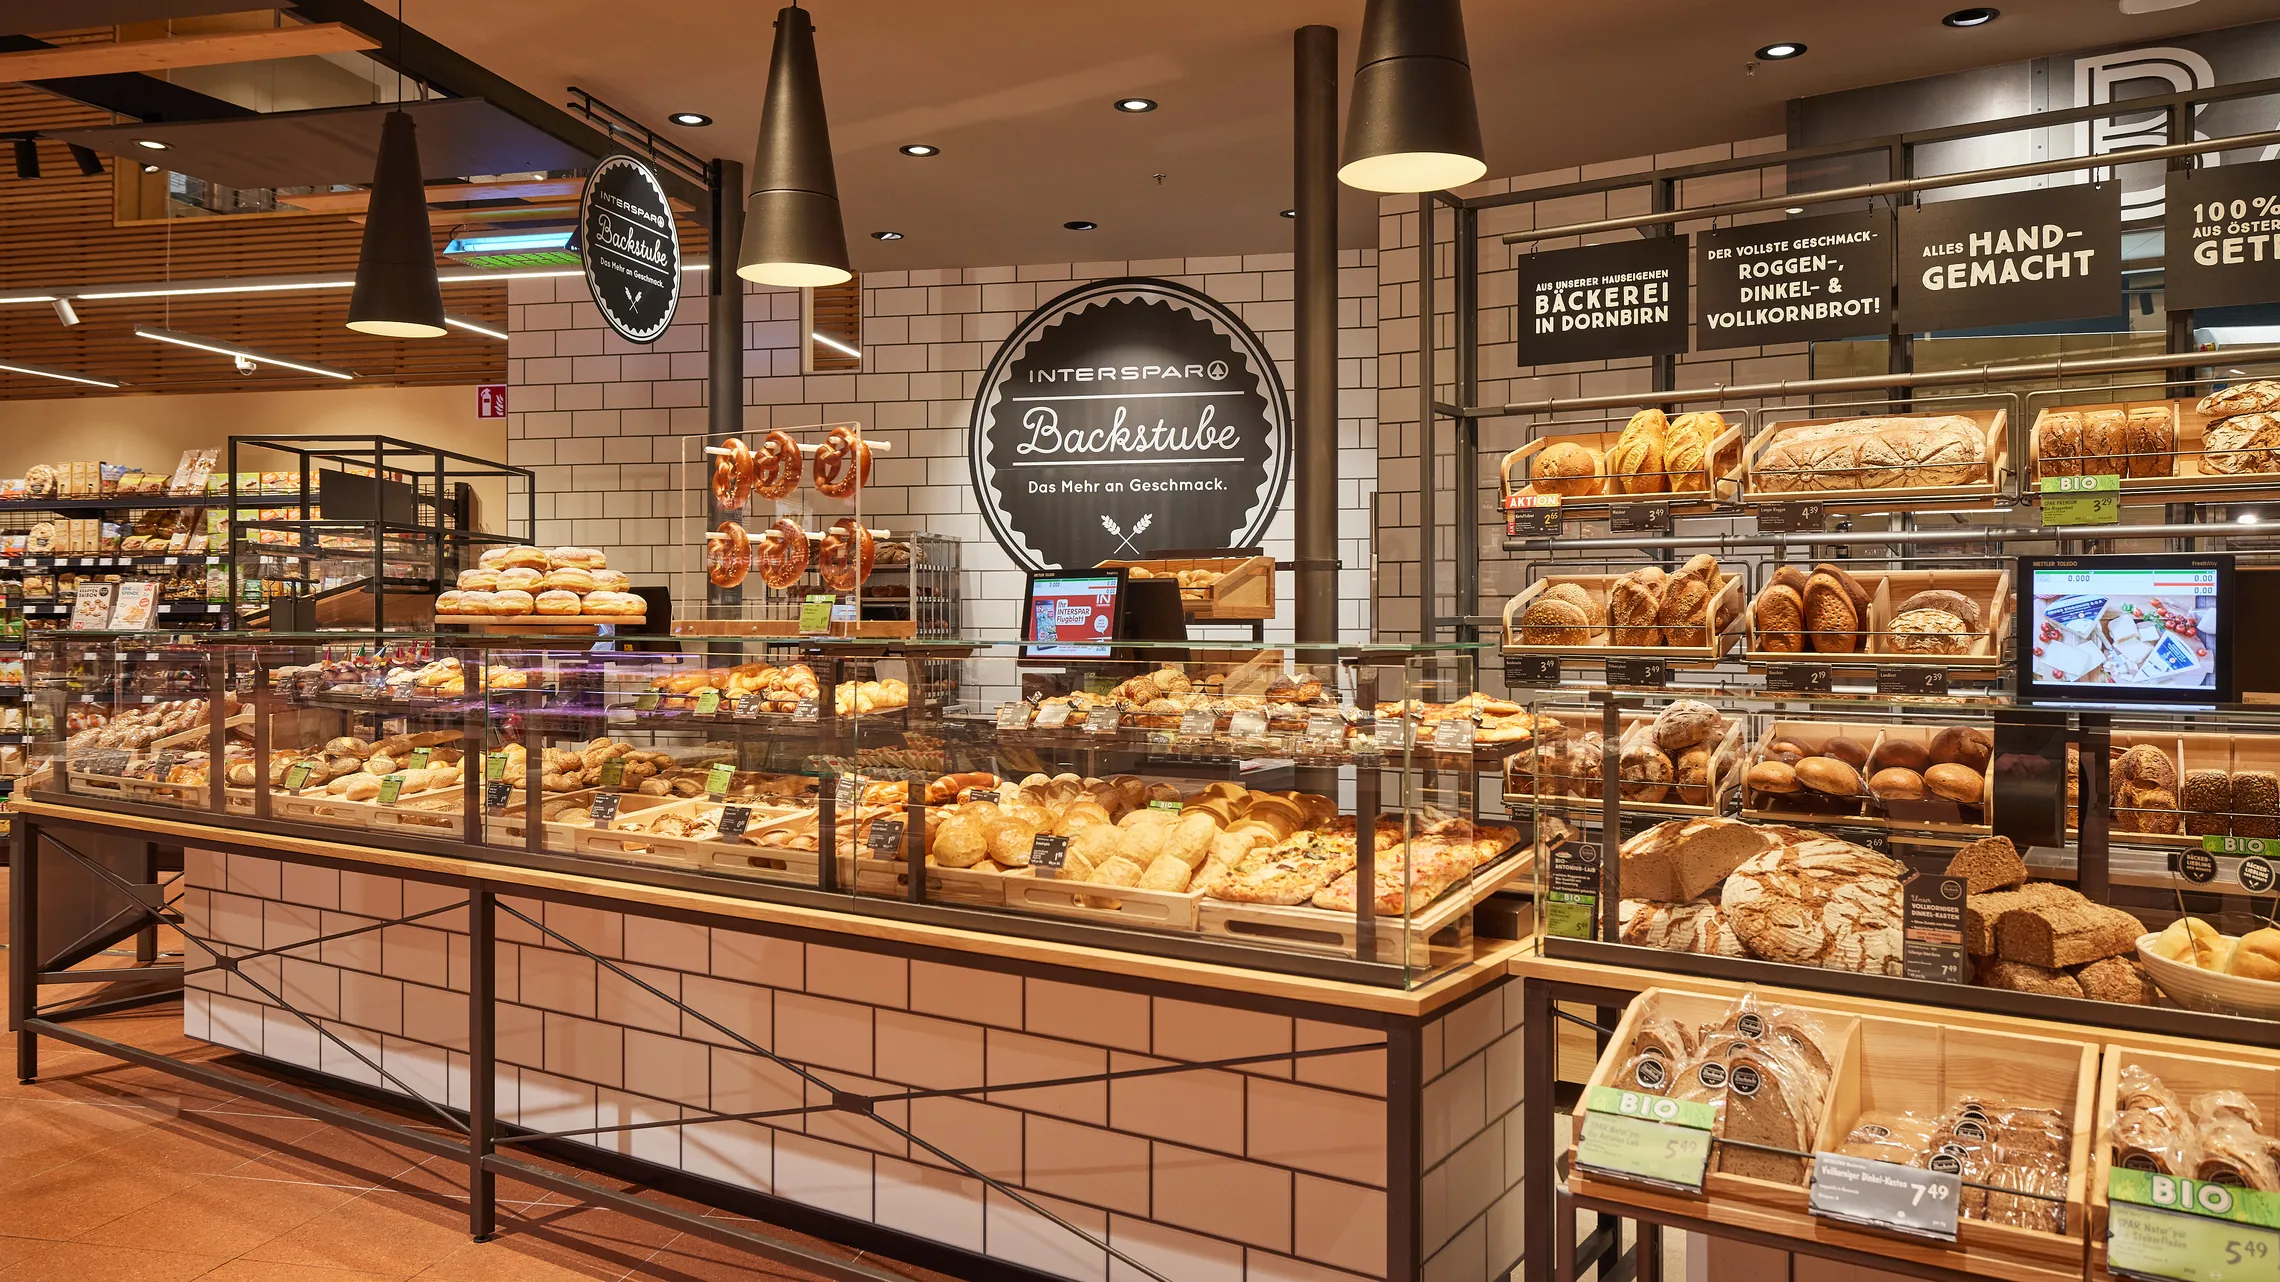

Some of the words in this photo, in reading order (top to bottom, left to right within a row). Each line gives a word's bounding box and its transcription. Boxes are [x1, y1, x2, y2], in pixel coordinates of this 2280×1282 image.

[600, 190, 658, 225] INTERSPAR
[596, 213, 668, 267] Backstube
[1922, 242, 1964, 258] ALLES
[1968, 224, 2083, 257] HAND-
[2192, 225, 2222, 239] AUS
[1708, 248, 1732, 261] DER
[1736, 241, 1789, 257] VOLLSTE
[1793, 230, 1878, 250] GESCHMACK-
[600, 256, 611, 268] Das
[611, 260, 625, 275] Mehr
[626, 267, 633, 277] an
[633, 268, 665, 289] Geschmack.
[1738, 254, 1845, 280] ROGGEN-,
[1922, 249, 2095, 291] GEMACHT
[1535, 282, 1553, 292] AUS
[1555, 277, 1599, 290] UNSERER
[1601, 269, 1669, 285] HAUSEIGENEN
[1740, 280, 1820, 303] DINKEL-
[1828, 277, 1843, 294] &
[1535, 281, 1669, 315] BÄCKEREI
[1535, 316, 1554, 334] IN
[1561, 305, 1669, 332] DORNBIRN
[1707, 297, 1880, 330] VOLLKORNBROT!
[1029, 364, 1204, 383] INTERSPAR
[1016, 404, 1241, 455] Backstube
[1028, 480, 1056, 494] Das
[1061, 479, 1100, 493] Mehr
[1105, 481, 1124, 492] an
[1129, 477, 1228, 492] Geschmack.
[2060, 476, 2098, 491] BIO
[1509, 495, 1558, 508] AKTION
[2068, 574, 2090, 582] 0.000
[2194, 574, 2213, 582] 0.00
[1096, 594, 1111, 604] IN
[2194, 586, 2213, 594] 0.00
[1056, 616, 1084, 624] Flugblatt
[2224, 837, 2265, 853] BIO
[1555, 864, 1596, 873] ANTONIUS-LAIB
[2186, 860, 2212, 868] LIEBLING
[2245, 867, 2269, 878] LIEBLING
[1564, 893, 1580, 902] BIO
[1911, 903, 1960, 914] VOLLKORNIGER
[1911, 910, 1960, 921] DINKEL-KASTEN
[1619, 1092, 1680, 1119] BIO
[1821, 1165, 1861, 1182] Vollkorniger
[1861, 1172, 1908, 1189] Dinkel-Kasten
[2151, 1174, 2234, 1214] BIO
